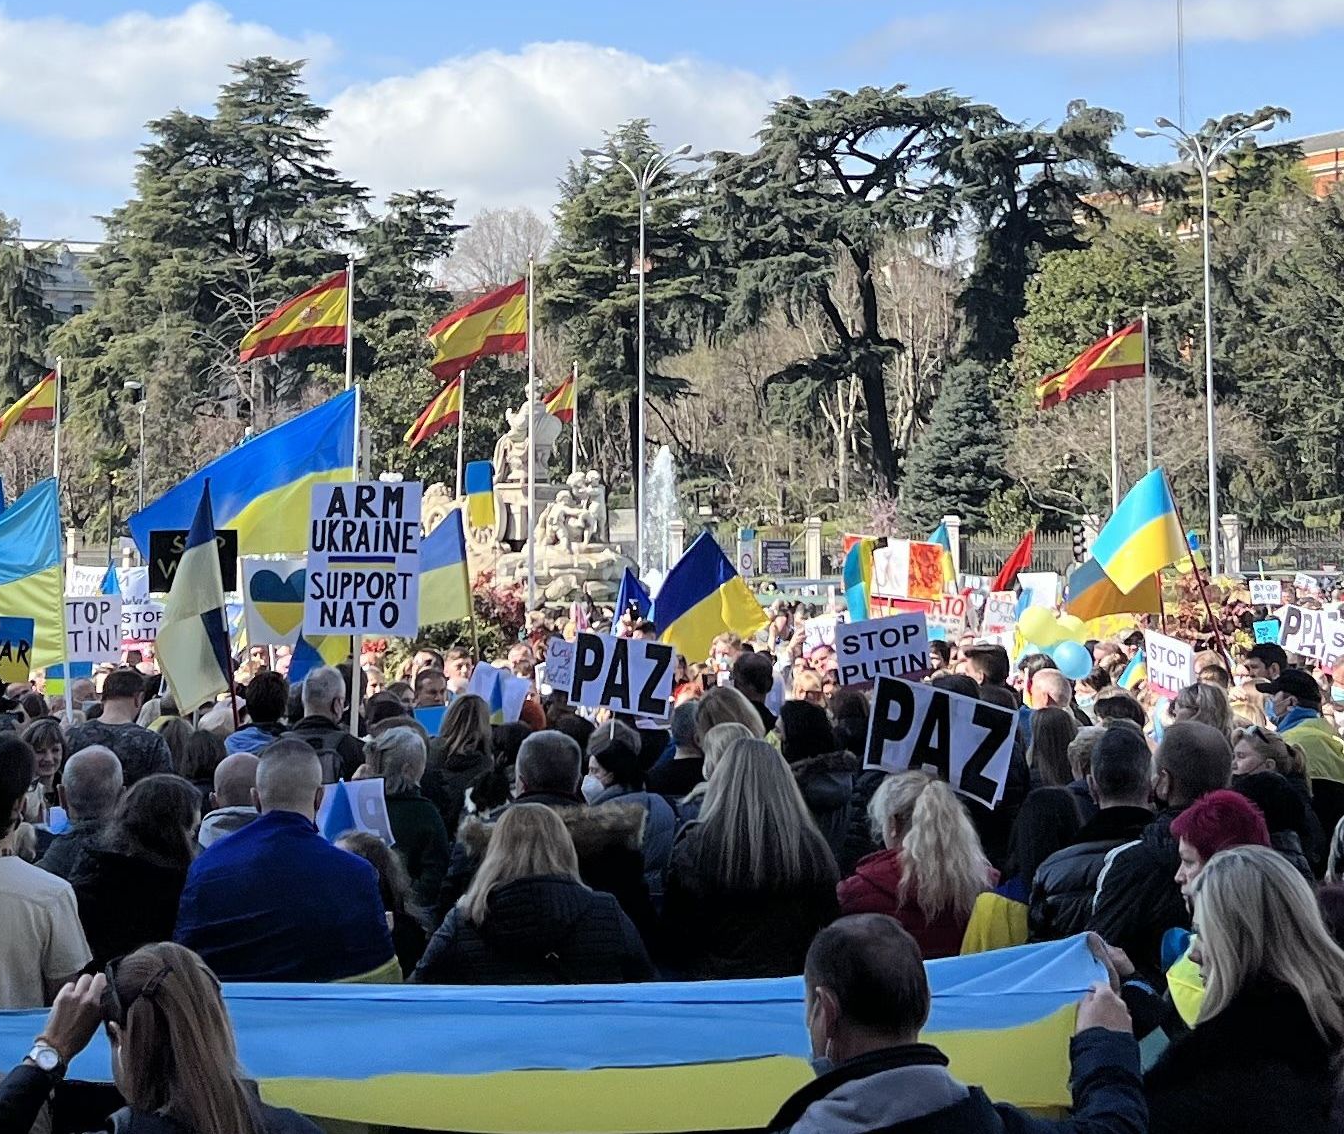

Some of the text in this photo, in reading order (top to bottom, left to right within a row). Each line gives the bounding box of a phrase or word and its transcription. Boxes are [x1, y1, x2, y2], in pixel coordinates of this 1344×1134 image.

[326, 485, 404, 519] ARM
[310, 572, 413, 600] SUPPORT
[1254, 584, 1278, 592] STOP
[66, 602, 111, 626] TOP
[320, 601, 399, 628] NATO
[122, 628, 157, 640] PUTI
[843, 624, 920, 655] STOP
[842, 651, 927, 686] PUTIN
[1150, 642, 1185, 669] STOP
[571, 633, 672, 715] PAZ
[867, 677, 1014, 805] PAZ
